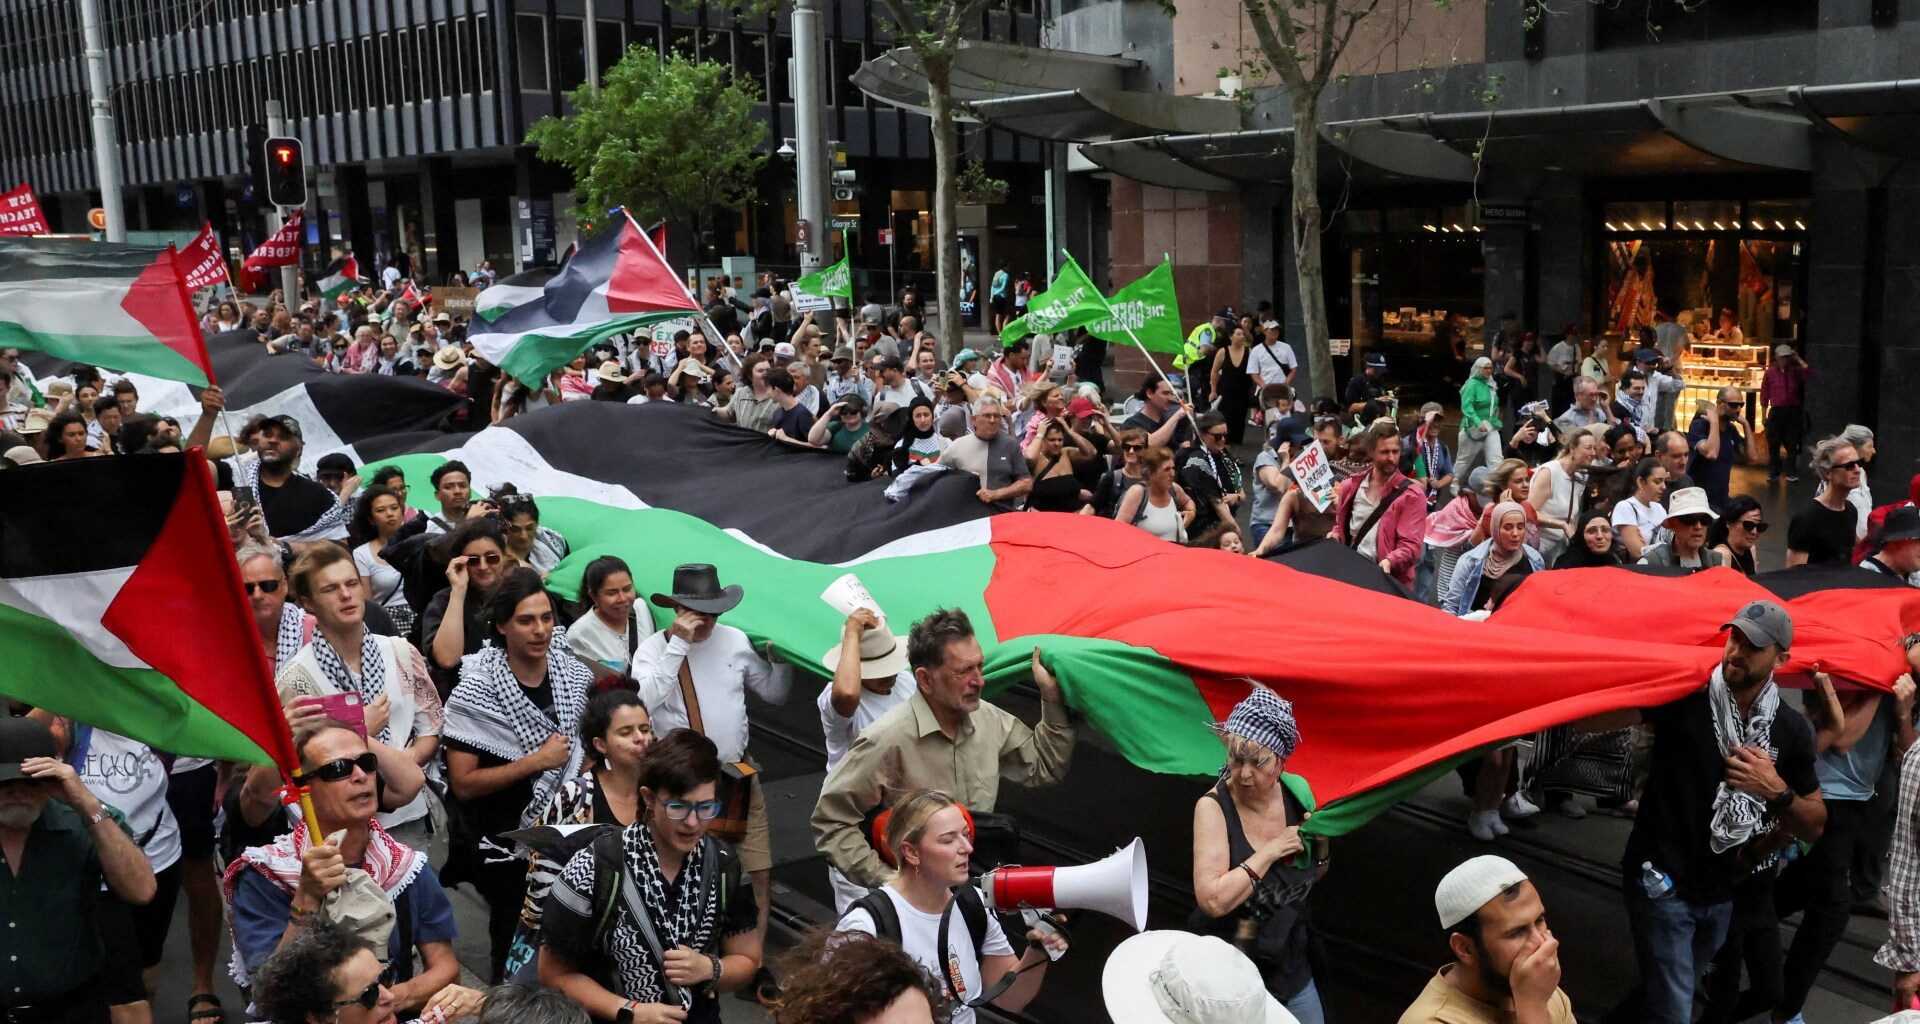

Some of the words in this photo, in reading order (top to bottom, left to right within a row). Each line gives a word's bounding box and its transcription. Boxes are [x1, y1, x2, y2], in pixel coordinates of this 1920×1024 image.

[831, 219, 850, 230] George
[851, 219, 857, 228] St
[1296, 446, 1318, 479] STOP
